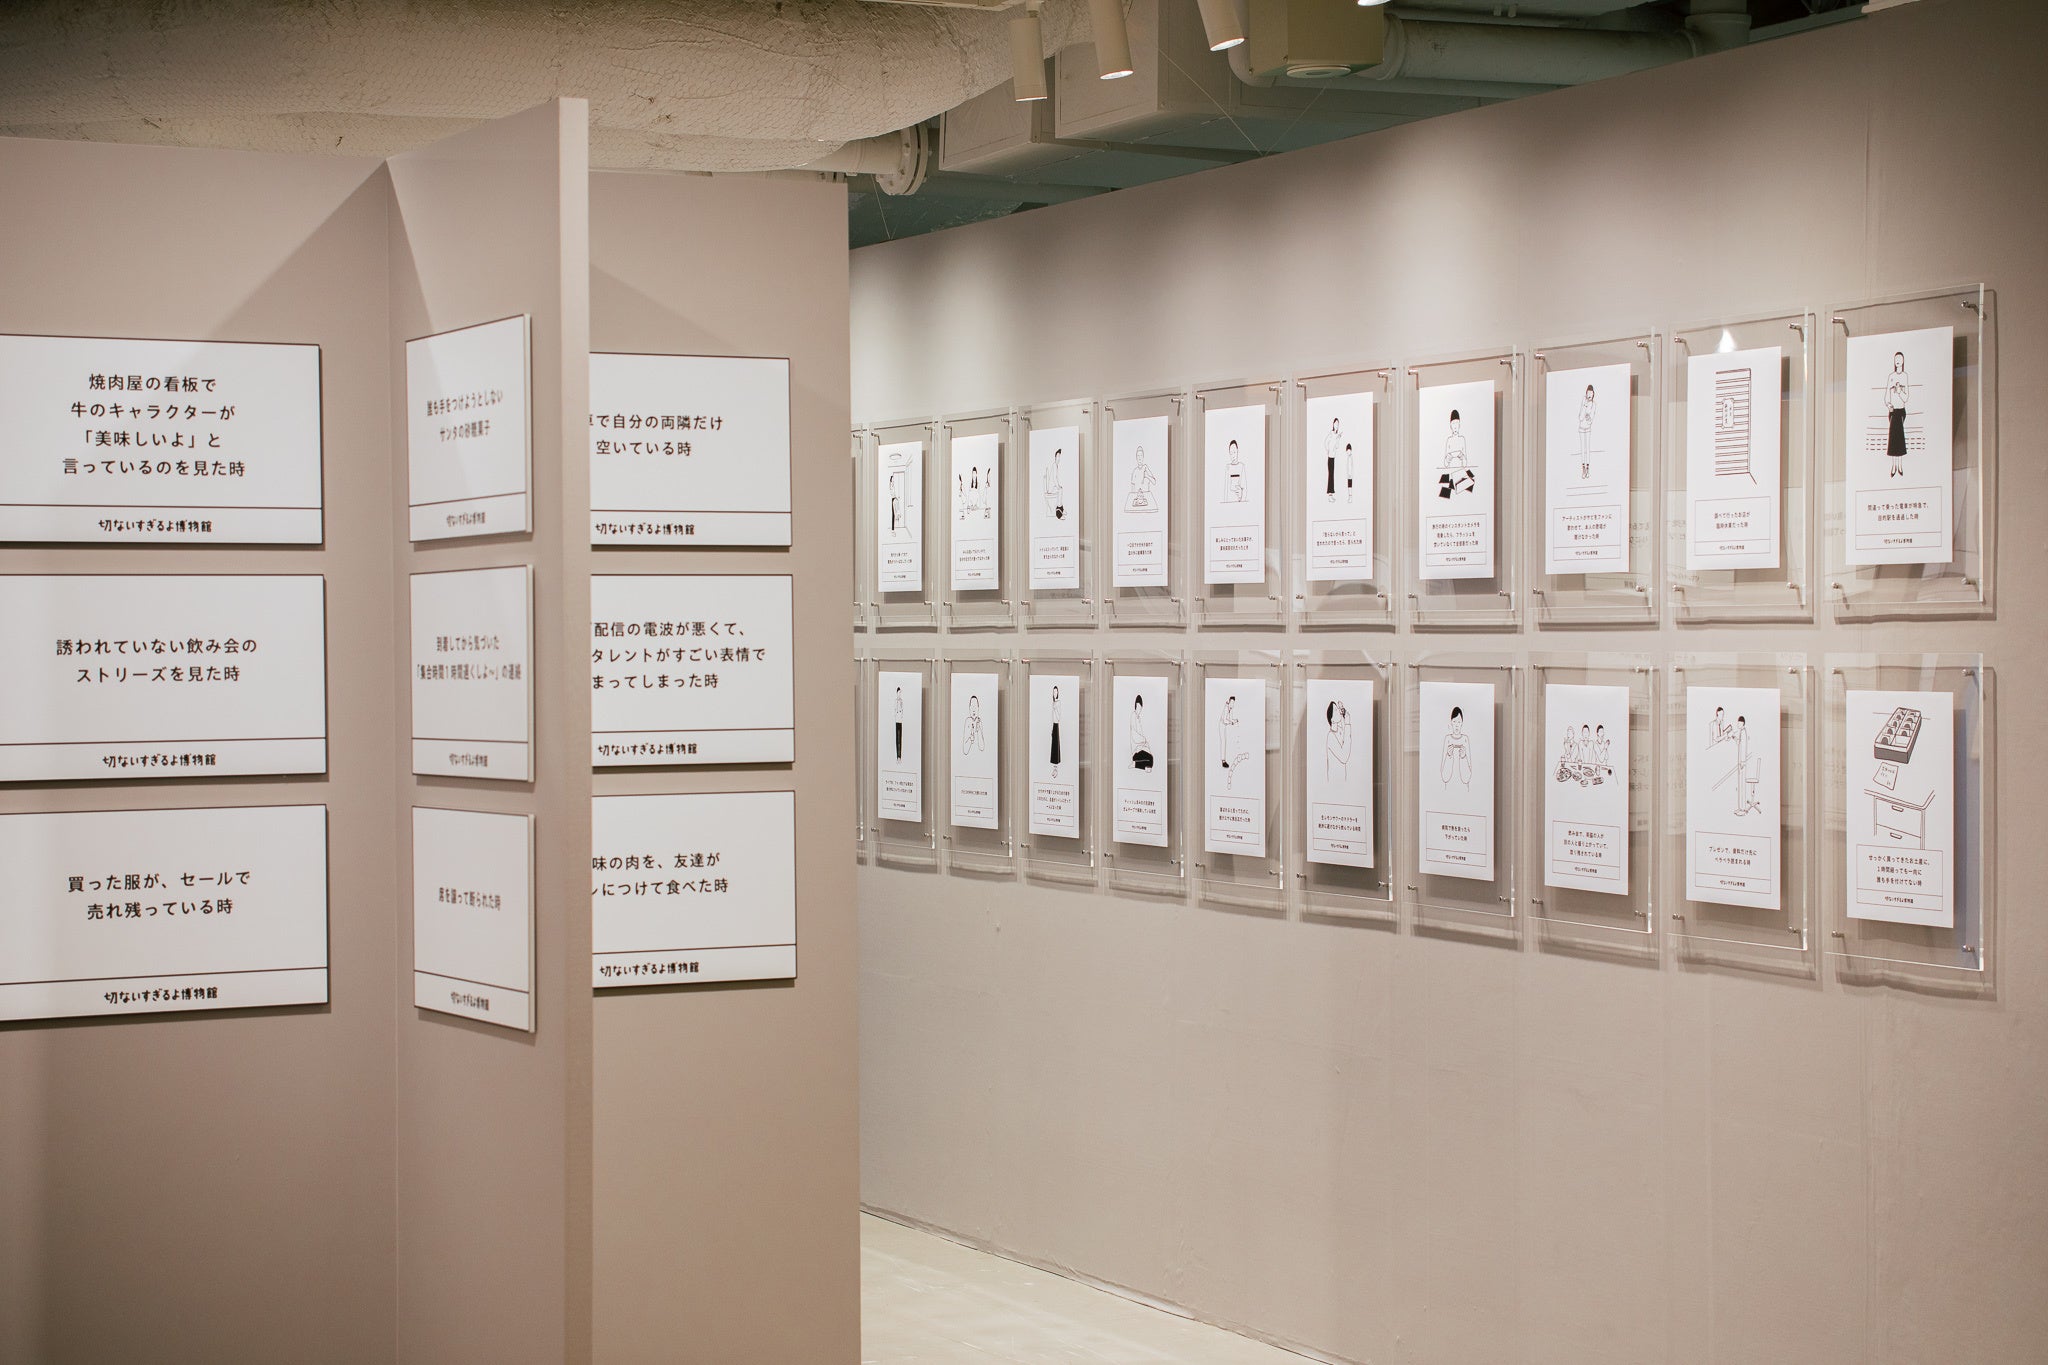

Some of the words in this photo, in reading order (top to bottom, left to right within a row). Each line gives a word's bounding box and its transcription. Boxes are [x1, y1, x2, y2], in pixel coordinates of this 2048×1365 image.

[89, 374, 216, 392] 焼肉屋の看板で
[71, 401, 235, 420] 牛のキャラクターが
[86, 430, 220, 448] 「美味しいよ」と
[597, 440, 691, 456] 空いている時
[63, 459, 245, 477] 言っているのを見た時
[98, 519, 212, 532] 切ないすぎるよ博物館
[595, 523, 694, 535] 切ないすぎるよ博物館
[56, 638, 256, 655] 誘われていない飲み会の
[592, 647, 765, 663] タレントがすごい表情で
[77, 666, 239, 683] ストリーズを見た時
[593, 674, 718, 689] まってしまった時
[598, 743, 697, 756] 切ないすぎるよ博物館
[103, 754, 216, 768] 切ないすぎるよ博物館
[592, 853, 720, 871] 味の肉を、友達が
[68, 872, 250, 892] 買った服が、セールで
[88, 898, 232, 920] 売れ残っている時
[600, 962, 699, 977] 切ないすぎるよ博物館
[104, 987, 217, 1004] 切ないすぎるよ博物館
